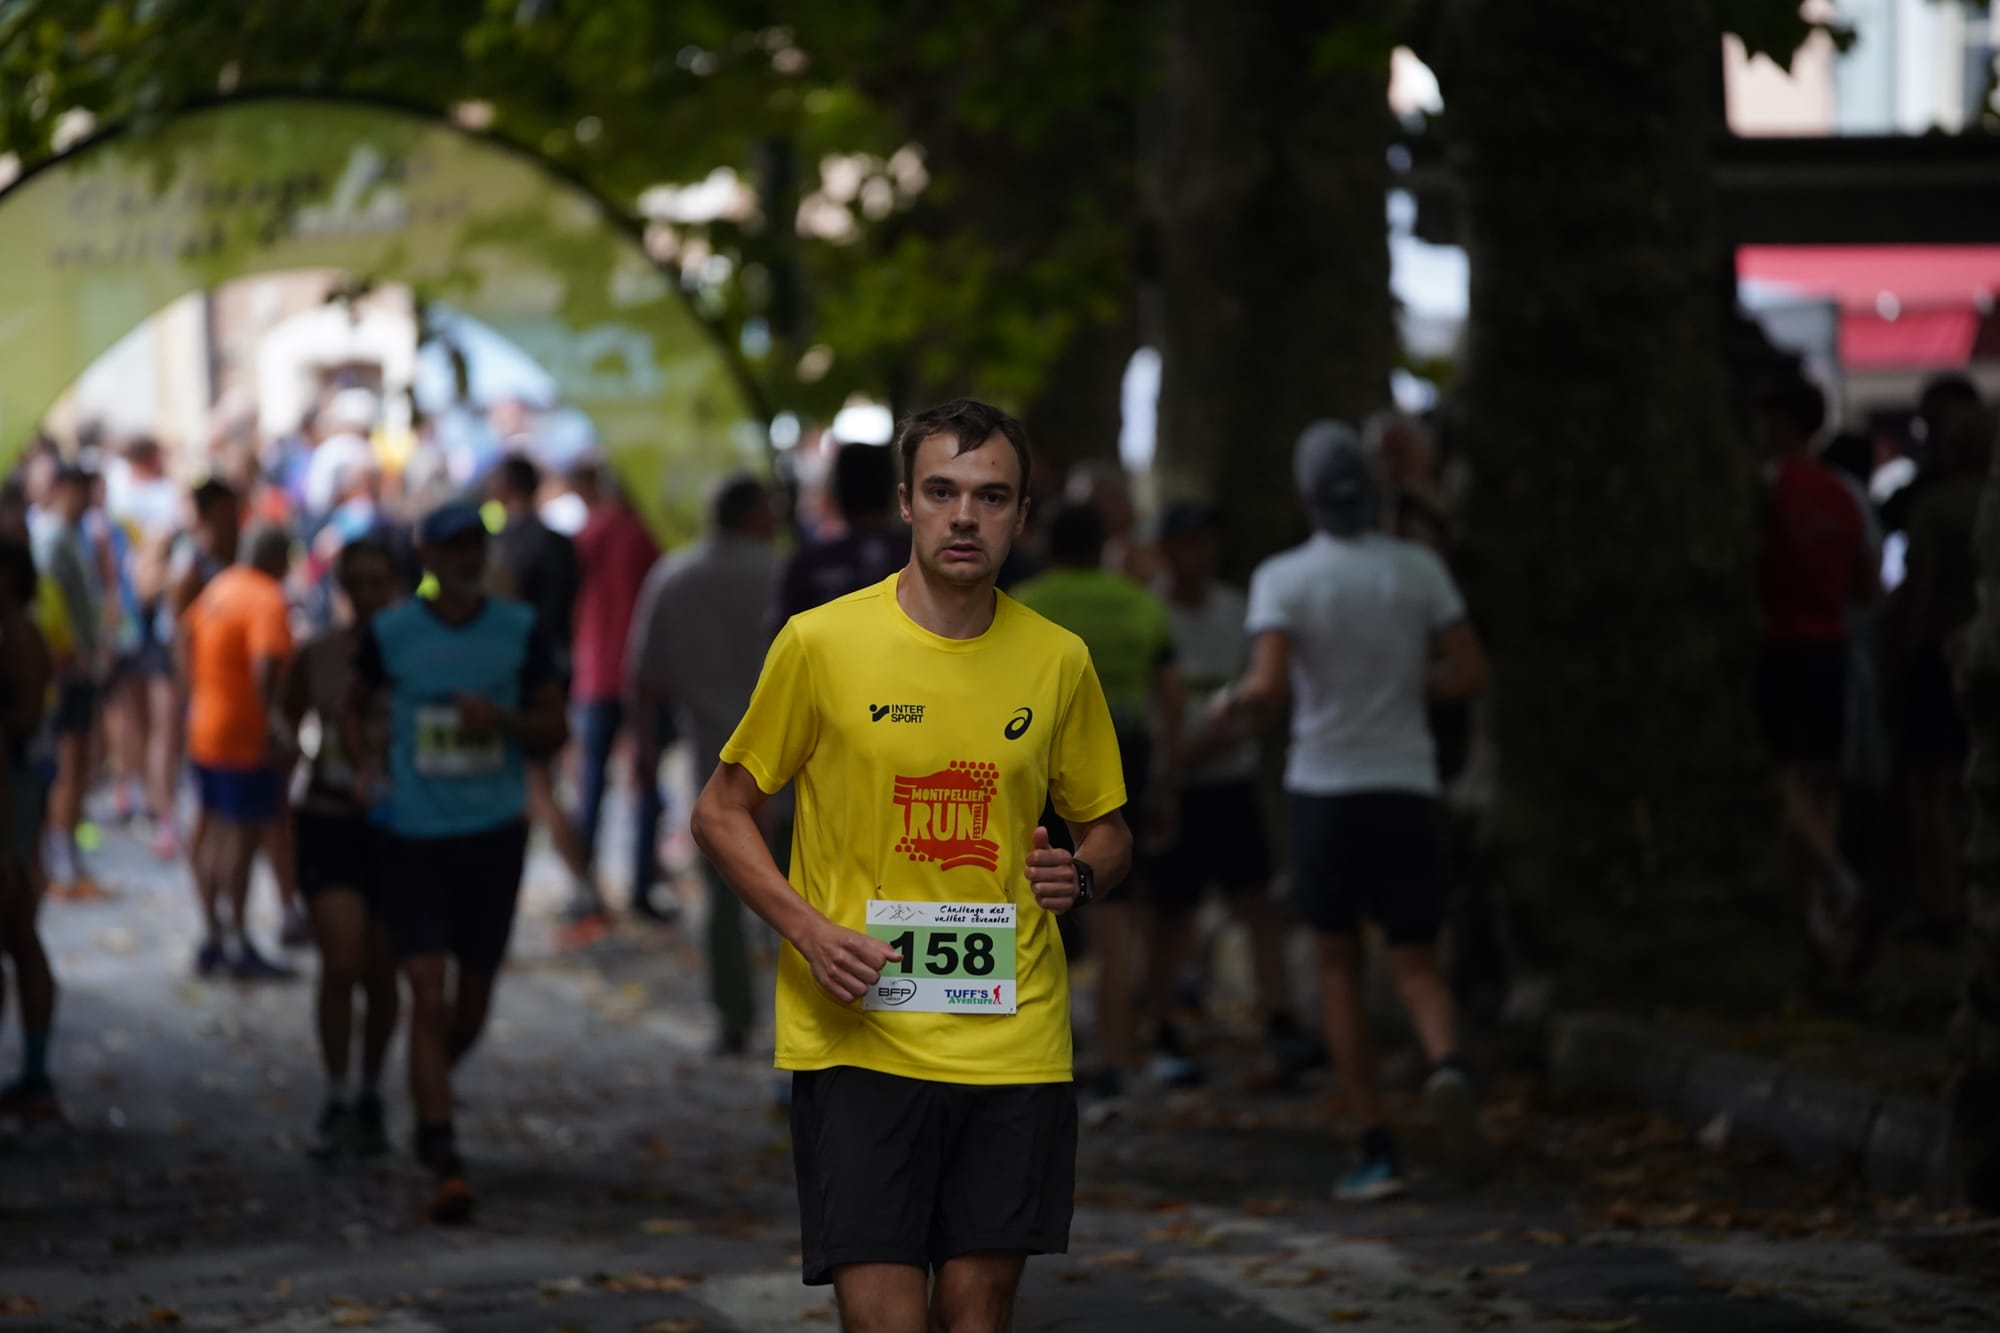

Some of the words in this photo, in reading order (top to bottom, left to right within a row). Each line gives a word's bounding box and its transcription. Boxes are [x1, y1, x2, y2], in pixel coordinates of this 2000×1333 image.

[891, 704, 924, 714] INTER
[891, 713, 923, 723] SPORT
[911, 788, 985, 802] MONTPELLIER
[910, 802, 974, 841] RUN
[939, 905, 984, 916] Challenge
[989, 906, 1005, 914] des
[890, 931, 995, 976] 158
[878, 987, 911, 997] BFP
[944, 989, 989, 999] TUFF'S
[948, 996, 993, 1005] Aventure
